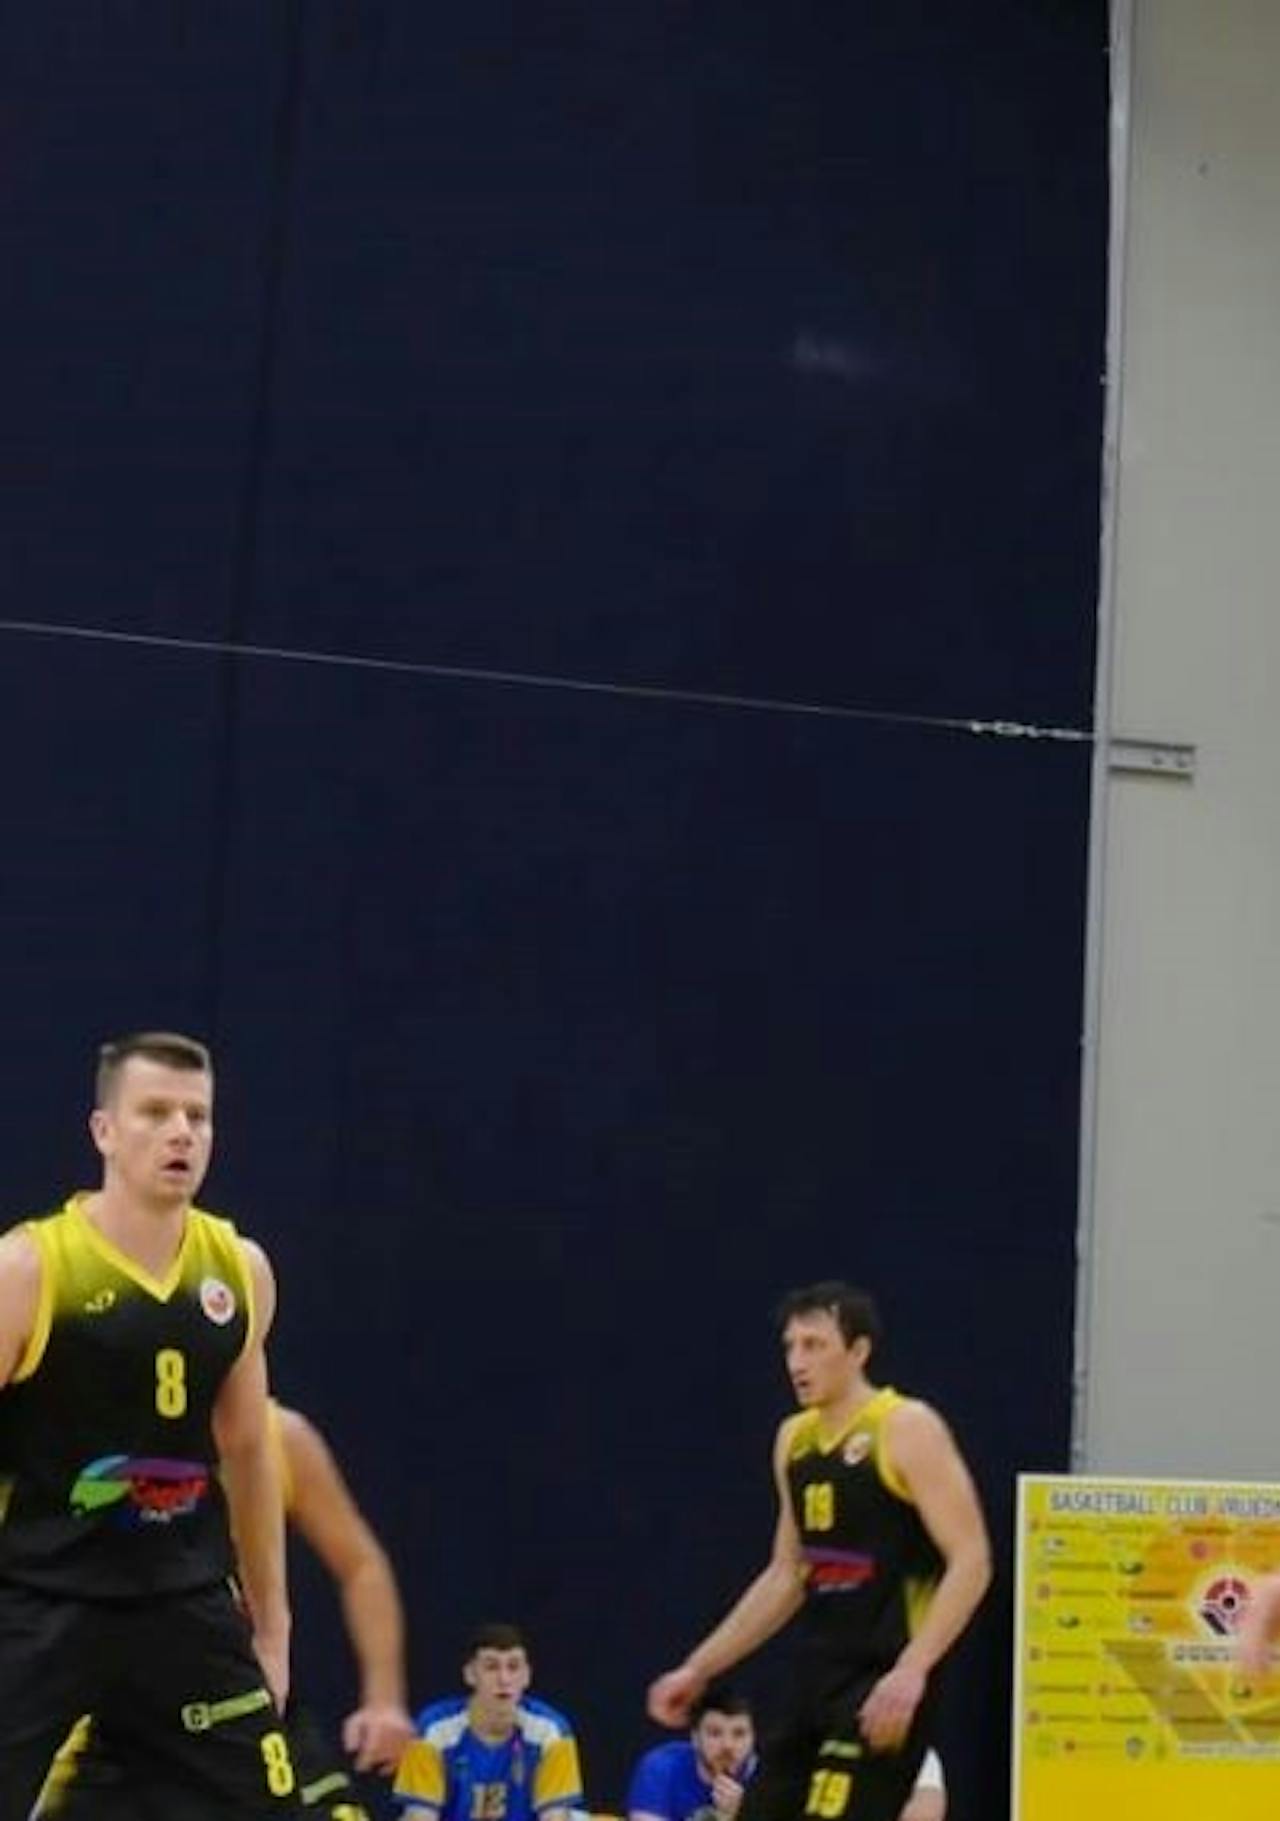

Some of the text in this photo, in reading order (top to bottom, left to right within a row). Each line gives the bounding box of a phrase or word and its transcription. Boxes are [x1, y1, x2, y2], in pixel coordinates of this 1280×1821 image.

[155, 1349, 188, 1418] 8
[260, 1732, 295, 1796] 8
[804, 1767, 855, 1821] 19
